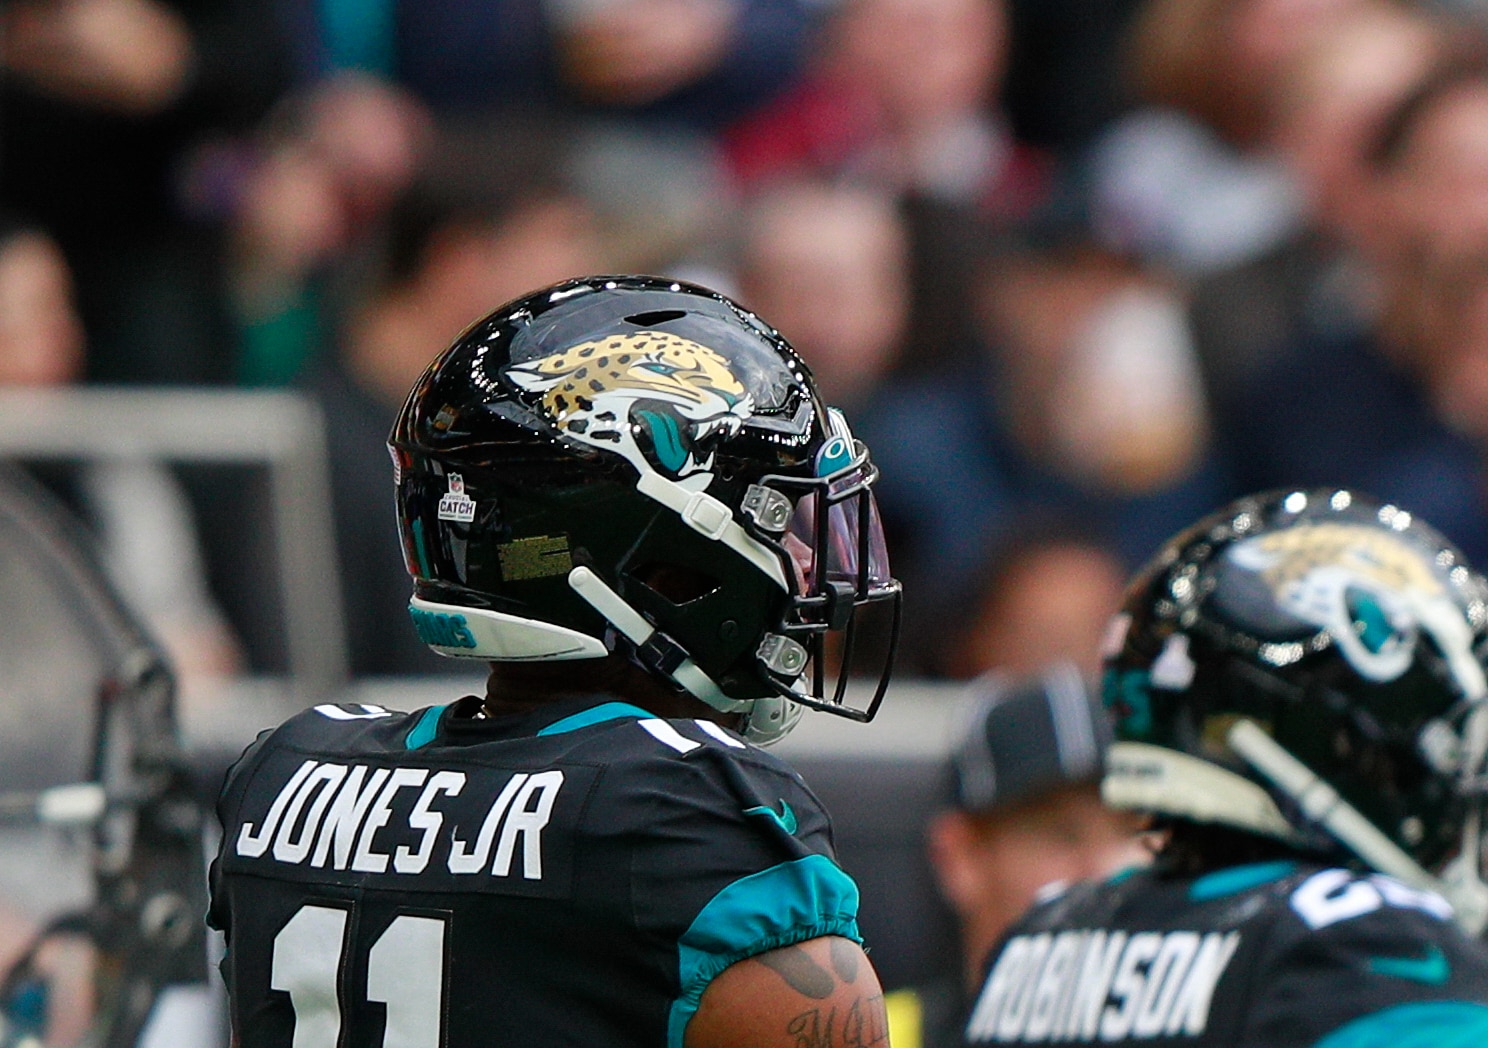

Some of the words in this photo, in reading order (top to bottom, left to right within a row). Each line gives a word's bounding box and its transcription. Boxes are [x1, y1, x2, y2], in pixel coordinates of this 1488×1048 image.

[440, 501, 474, 514] CATCH
[236, 760, 467, 875] JONES
[447, 769, 565, 880] JR
[966, 930, 1241, 1043] ROBINSON
